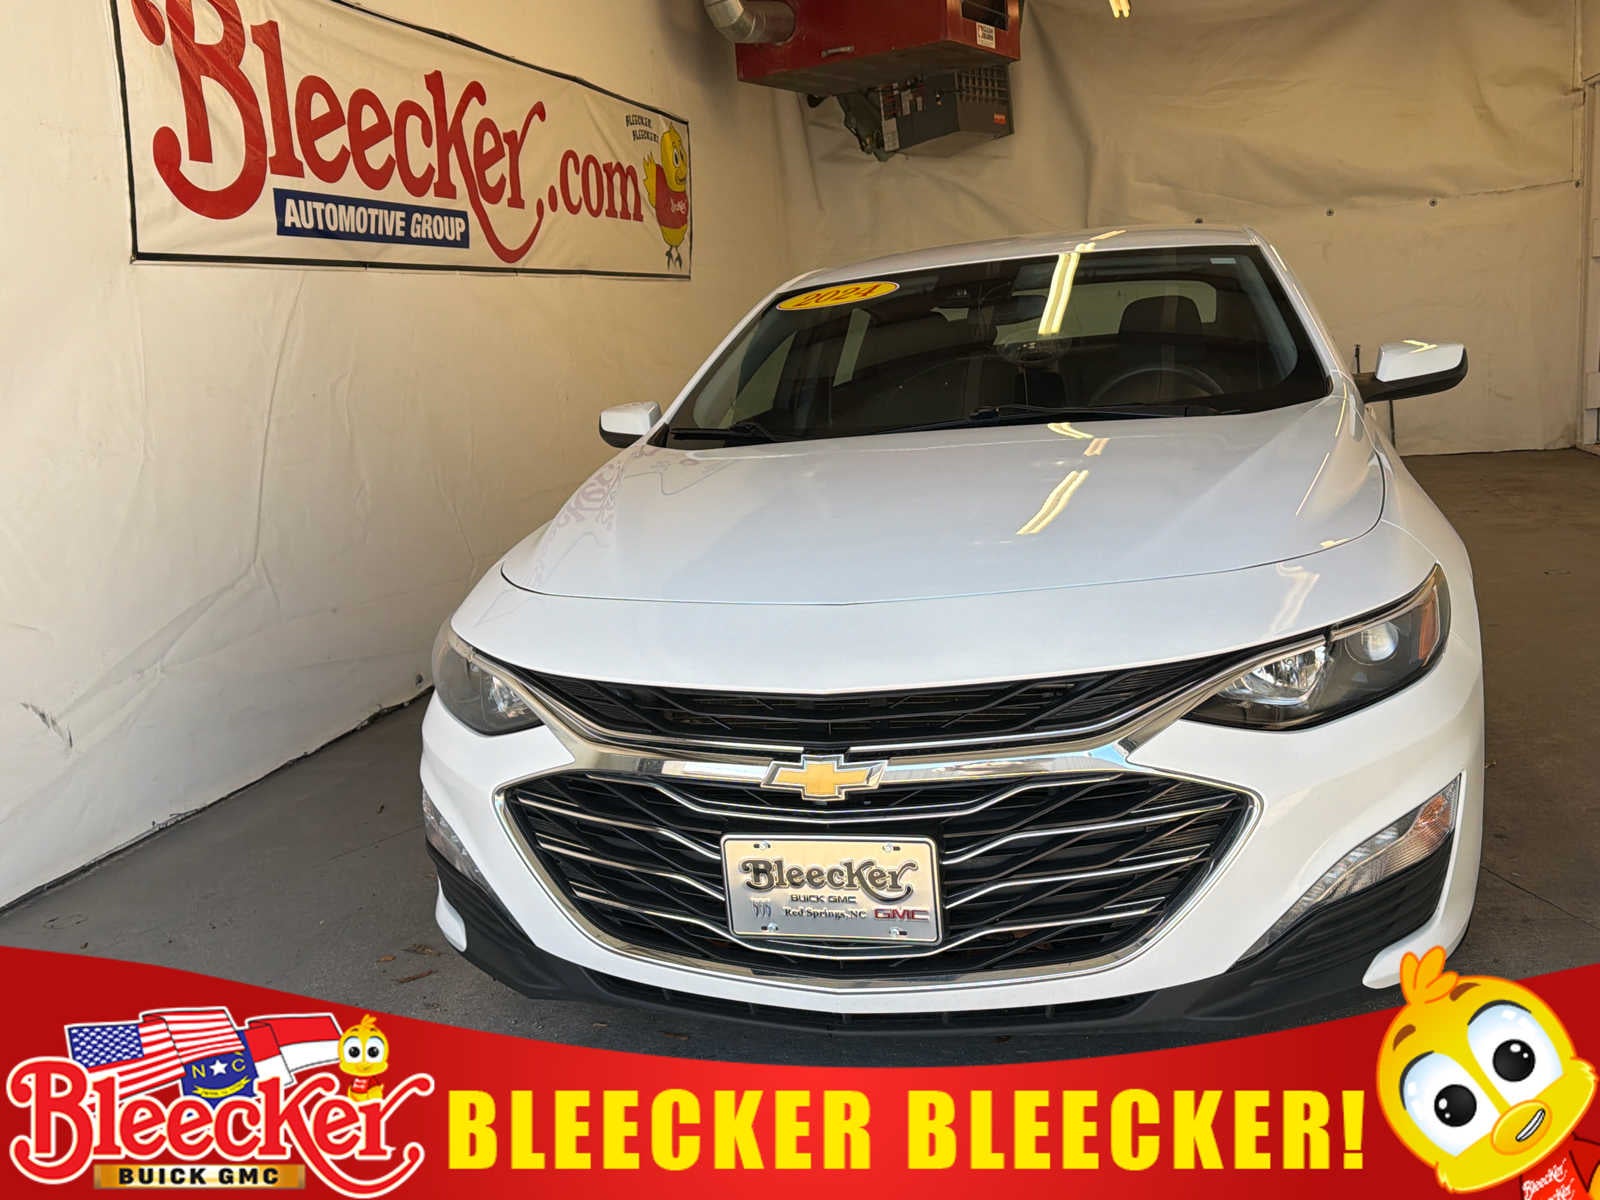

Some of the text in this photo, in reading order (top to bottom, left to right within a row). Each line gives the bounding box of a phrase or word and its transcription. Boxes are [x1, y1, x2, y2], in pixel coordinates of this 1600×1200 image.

[284, 198, 466, 243] AUTOMOTIVE GROUP
[793, 283, 881, 307] 2024
[790, 894, 857, 904] BUICK GMC
[784, 907, 804, 917] Red
[874, 908, 929, 921] GMC
